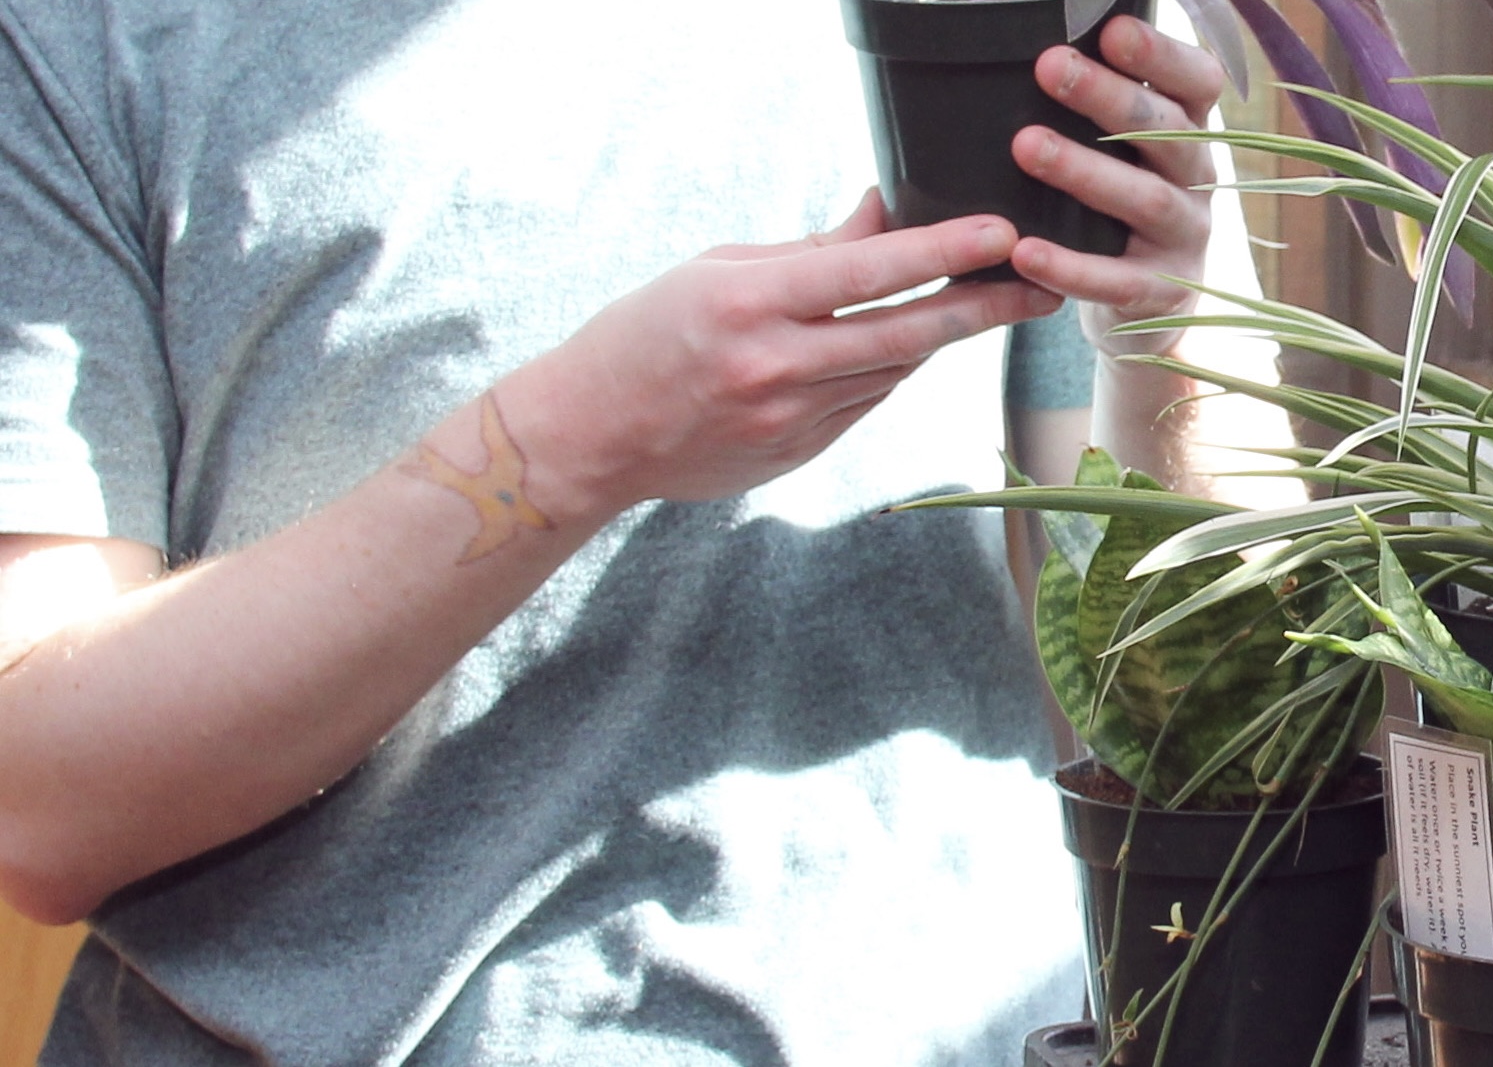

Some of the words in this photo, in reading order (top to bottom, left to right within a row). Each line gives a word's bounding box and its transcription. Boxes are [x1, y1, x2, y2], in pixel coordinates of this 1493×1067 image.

[1407, 755, 1415, 769] of
[1418, 758, 1426, 780] soil
[1418, 783, 1427, 798] (if
[1429, 760, 1437, 801] Water
[1447, 764, 1455, 798] Place
[1466, 767, 1476, 807] Snake
[1421, 801, 1427, 809] it
[1450, 802, 1457, 814] in
[1411, 814, 1417, 823] is
[1421, 813, 1430, 843] feels
[1451, 819, 1459, 840] the
[1470, 812, 1479, 846] Plant
[1411, 827, 1419, 842] all
[1434, 840, 1441, 854] or
[1413, 846, 1419, 855] it
[1435, 858, 1444, 893] twice
[1453, 844, 1464, 899] sunniest
[1426, 877, 1434, 914] water
[1439, 908, 1448, 941] week
[1457, 903, 1466, 931] spot
